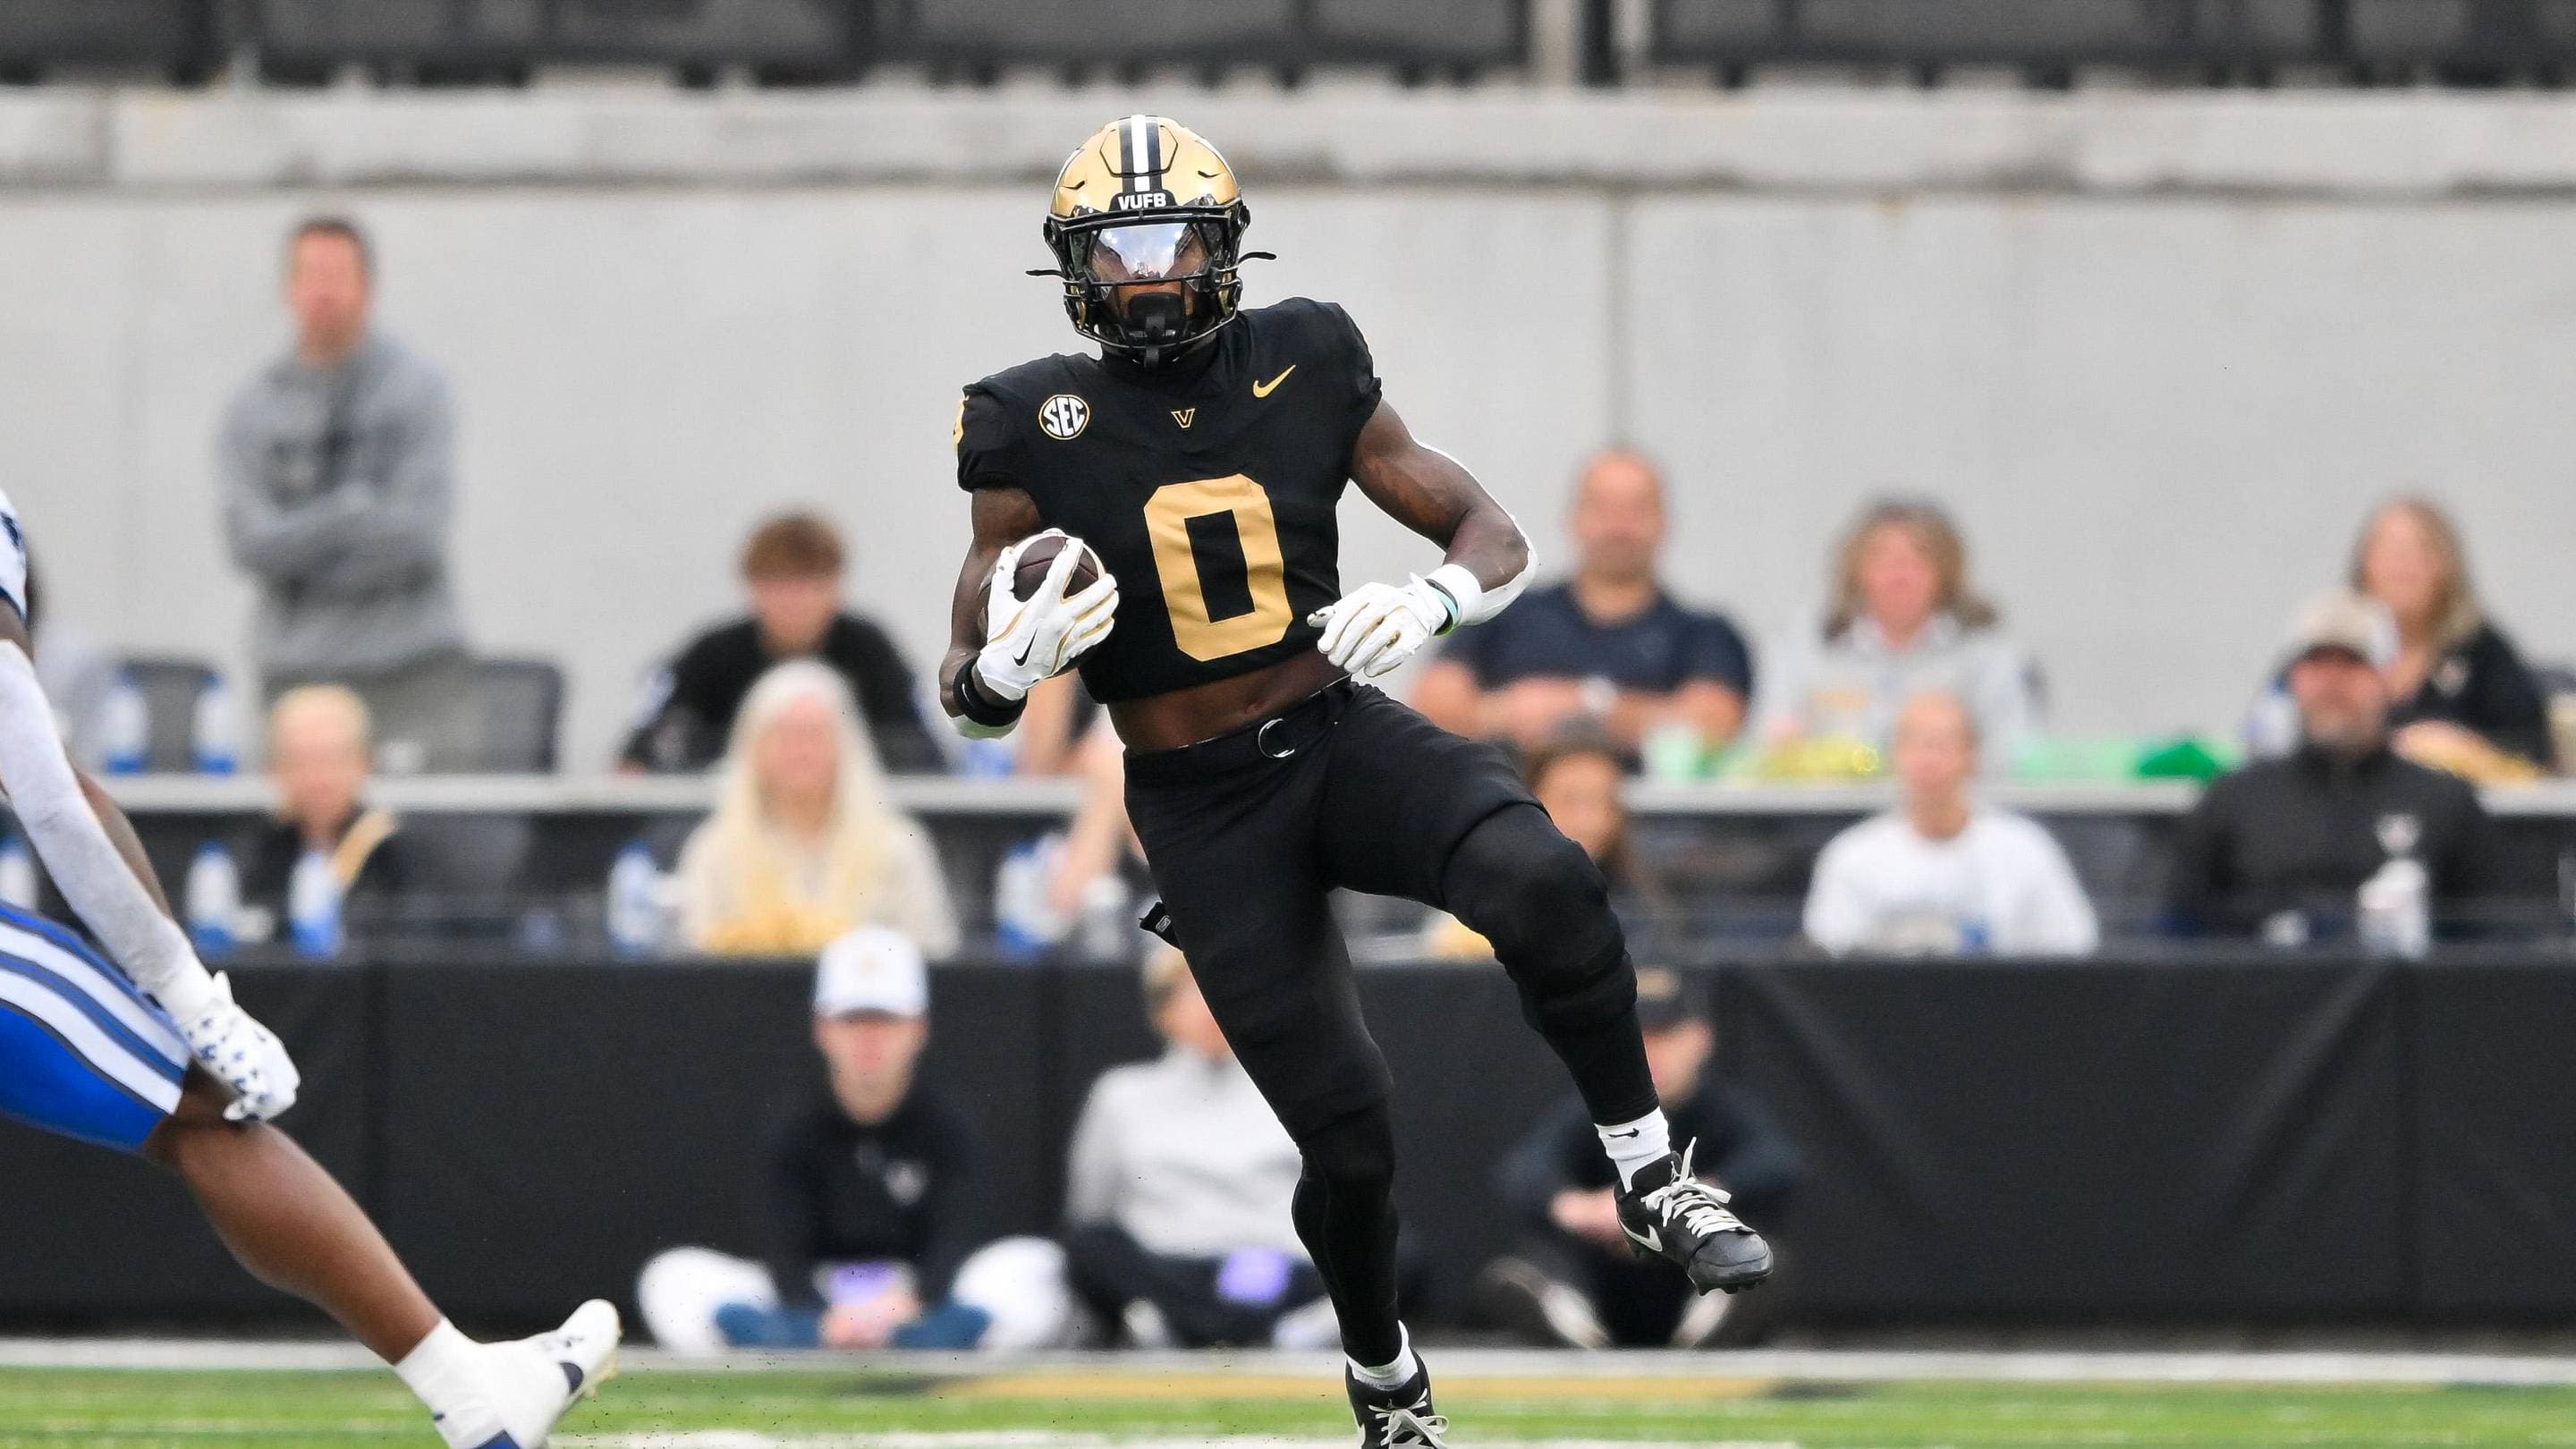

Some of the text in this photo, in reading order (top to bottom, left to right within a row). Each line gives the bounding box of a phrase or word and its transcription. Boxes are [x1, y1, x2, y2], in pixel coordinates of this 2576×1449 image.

[1117, 192, 1166, 211] VUFB
[1043, 397, 1085, 436] SEC
[1171, 408, 1195, 428] V
[1143, 473, 1293, 662] 0
